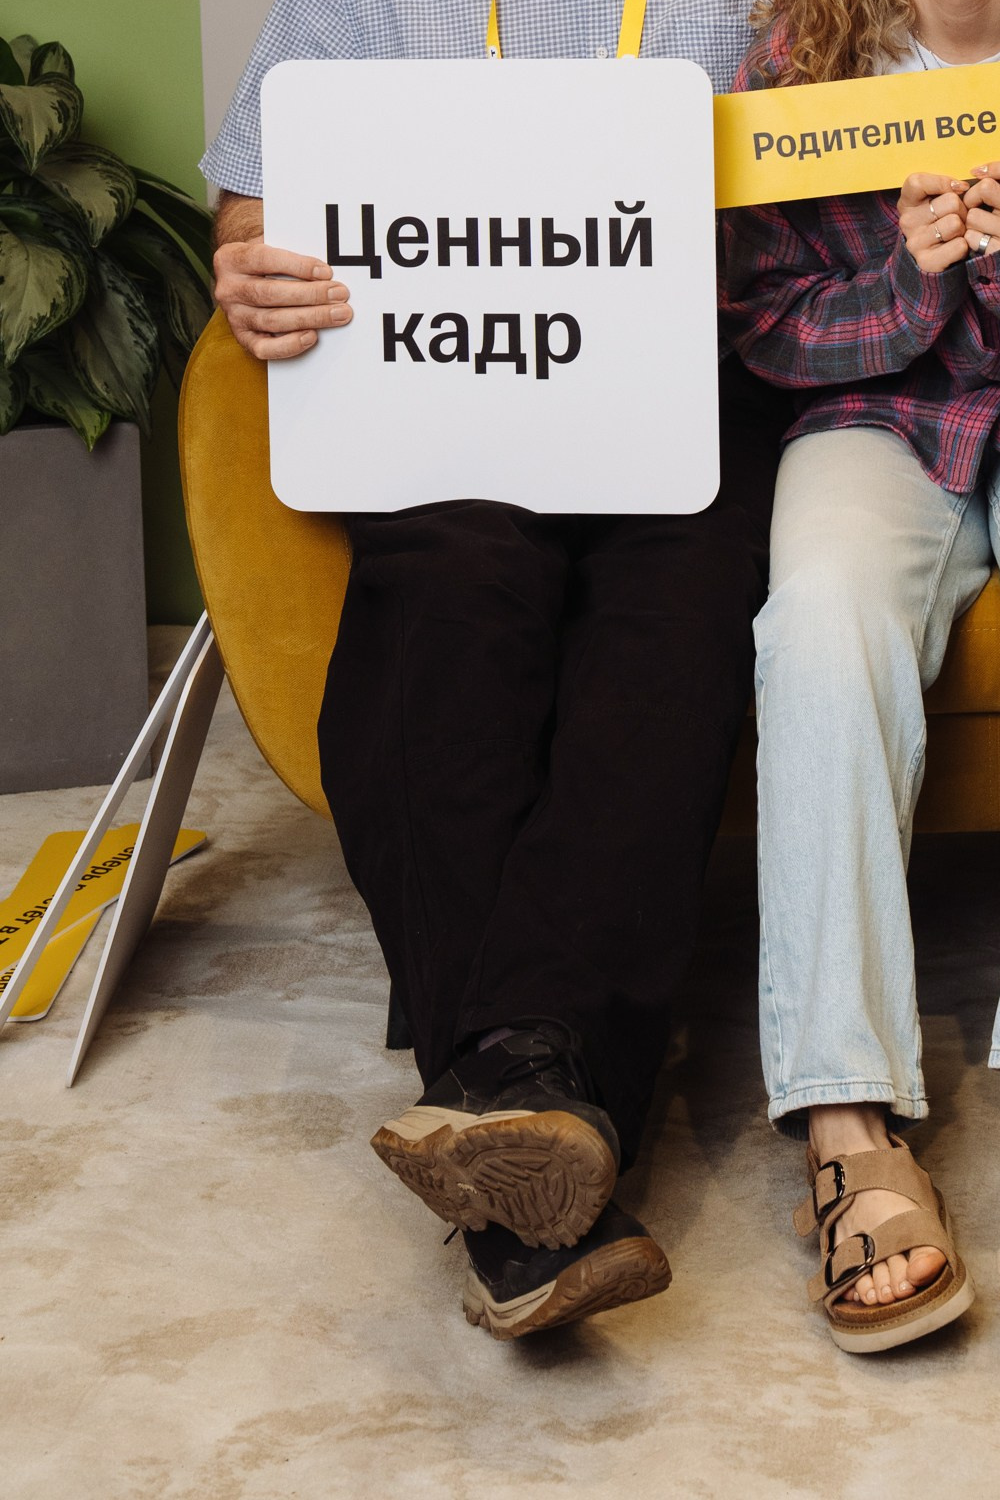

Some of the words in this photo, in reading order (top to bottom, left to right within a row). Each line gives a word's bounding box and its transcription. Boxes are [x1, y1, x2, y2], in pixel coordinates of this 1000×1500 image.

[753, 118, 926, 160] Родители
[937, 111, 997, 138] все
[325, 200, 653, 279] Ценный
[382, 312, 582, 380] кадр
